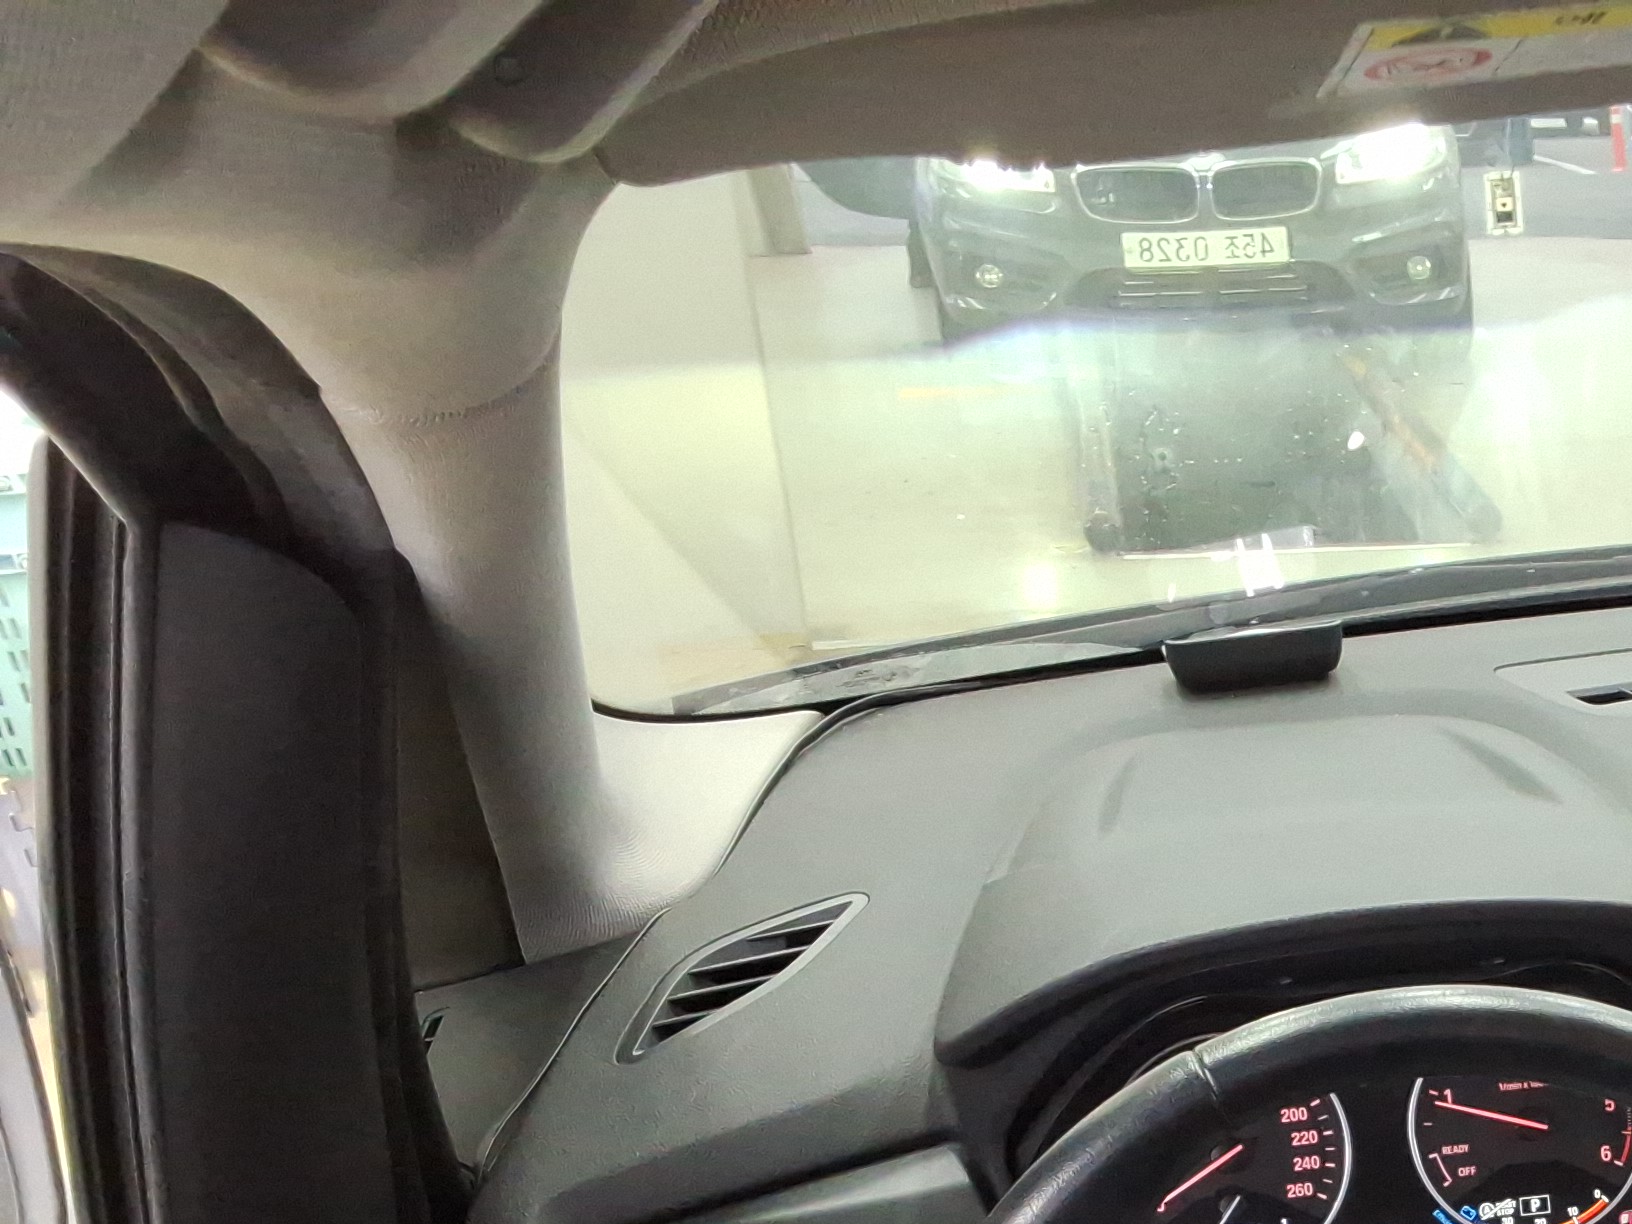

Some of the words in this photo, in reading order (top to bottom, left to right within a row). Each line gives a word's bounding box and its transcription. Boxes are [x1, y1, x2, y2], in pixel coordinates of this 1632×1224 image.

[1604, 1098, 1616, 1112] 5
[1280, 1107, 1308, 1123] 200
[1291, 1130, 1318, 1146] 220
[1441, 1143, 1470, 1155] READY
[1600, 1145, 1612, 1161] 6
[1293, 1155, 1320, 1171] 240
[1457, 1165, 1477, 1177] OFF
[1286, 1182, 1313, 1198] 260
[1530, 1199, 1540, 1212] P
[1567, 1206, 1579, 1217] 10
